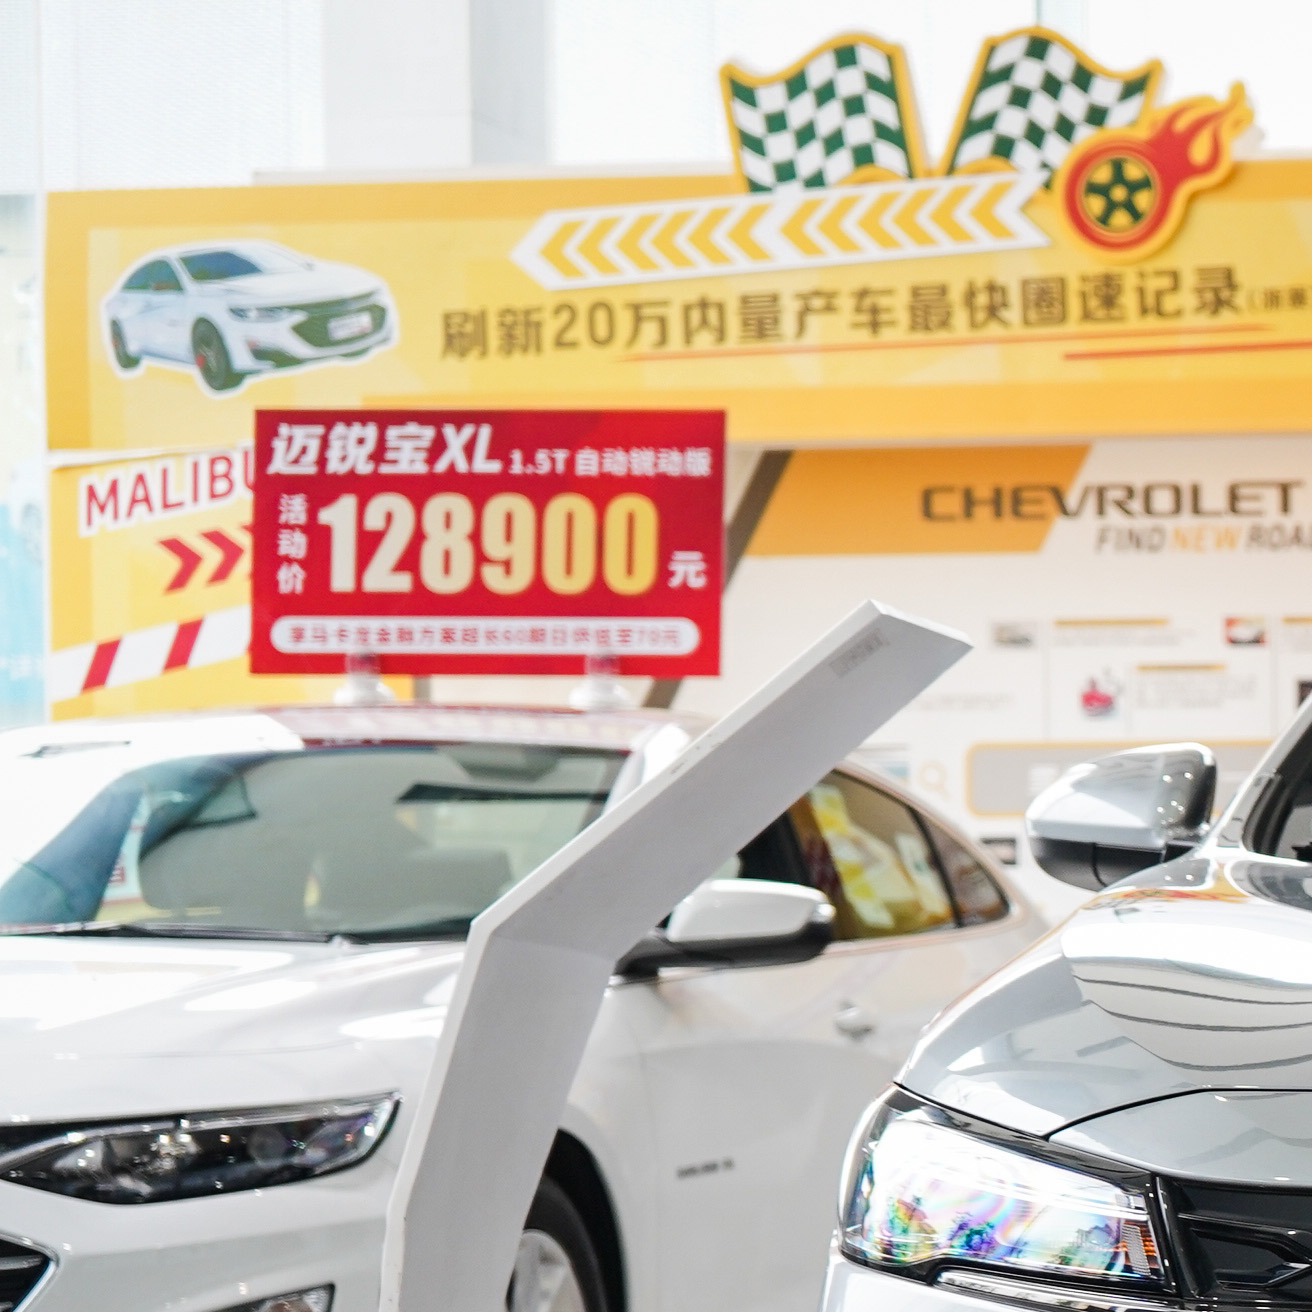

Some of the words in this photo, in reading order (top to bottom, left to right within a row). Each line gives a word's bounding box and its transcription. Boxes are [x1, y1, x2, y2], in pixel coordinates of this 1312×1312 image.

[266, 421, 504, 476] 迈锐宝XL
[508, 450, 570, 475] 1.5T
[920, 478, 1305, 523] CHEVROLET
[276, 492, 308, 595] 活动价
[318, 491, 660, 596] 128900
[667, 550, 708, 589] 元
[1094, 524, 1167, 554] FIND
[1170, 524, 1243, 552] NEW
